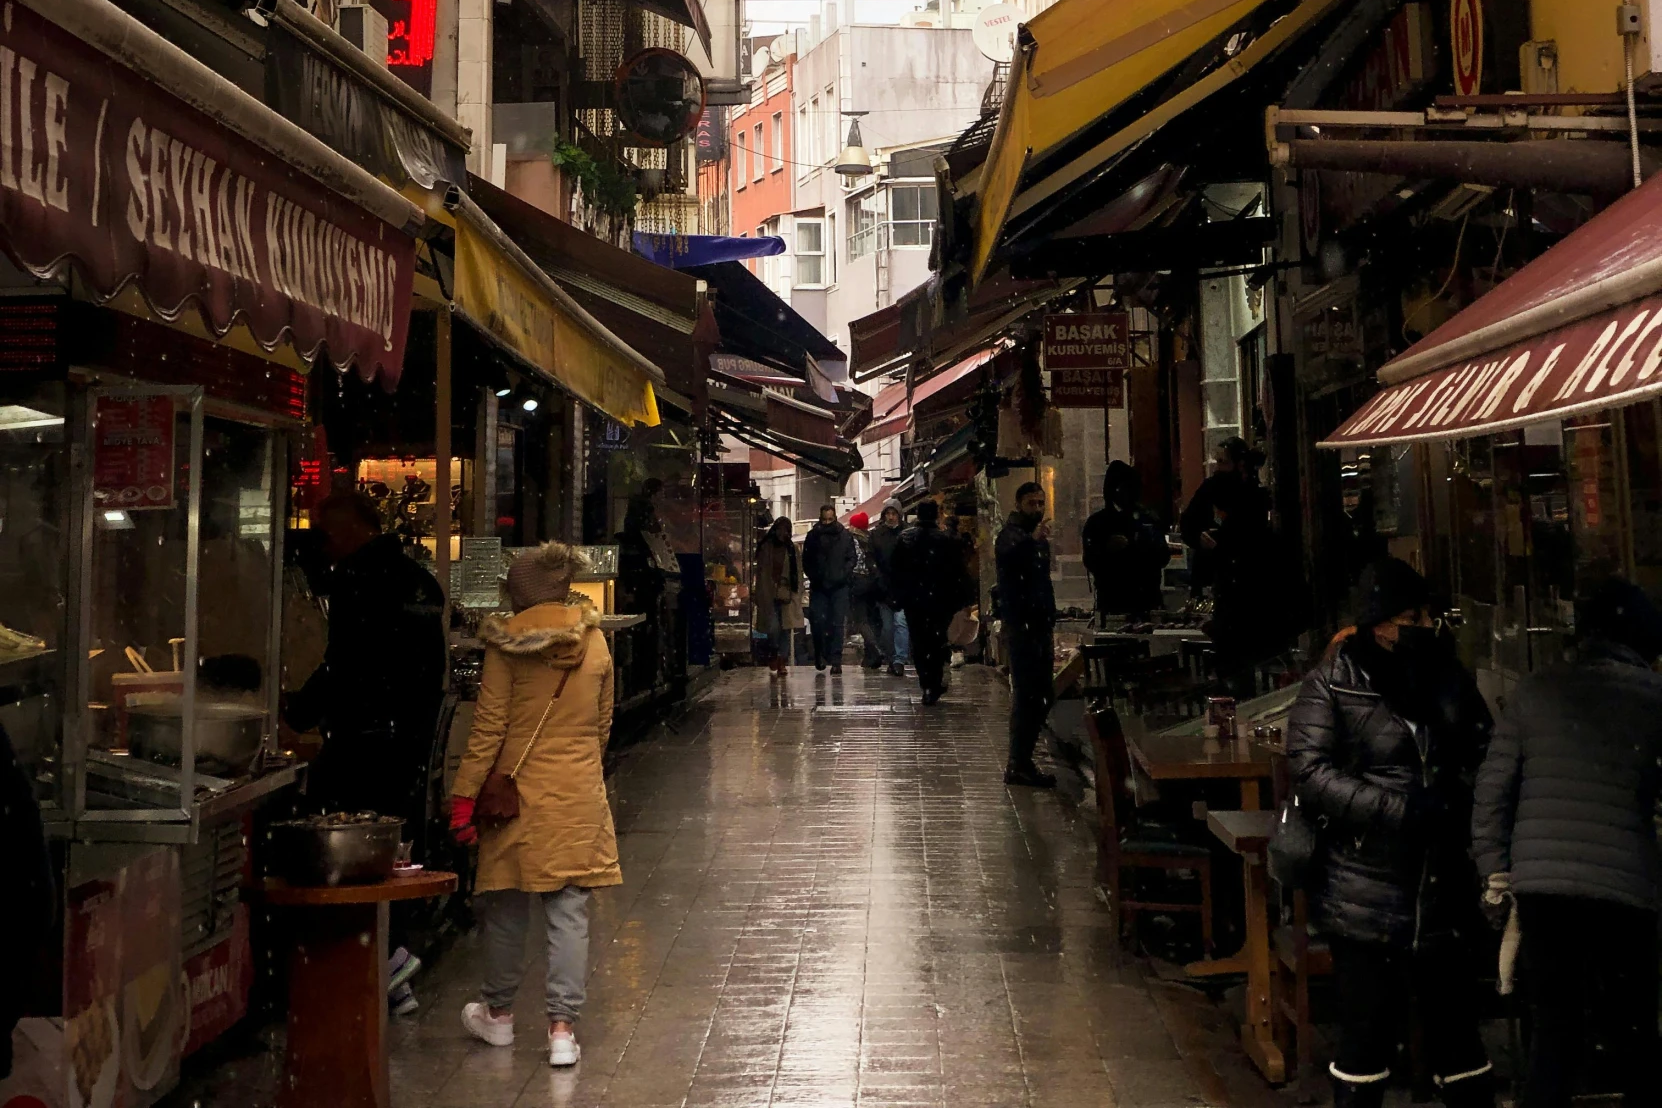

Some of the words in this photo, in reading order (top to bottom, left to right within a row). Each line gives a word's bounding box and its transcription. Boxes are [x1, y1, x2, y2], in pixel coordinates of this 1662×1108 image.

[984, 15, 1012, 27] VESTEL
[126, 117, 260, 283] SEYHAN
[266, 191, 396, 351] KURUYEMİŞ
[1055, 324, 1117, 344] BAŞAK
[1047, 342, 1126, 356] KURUYEMİŞ
[1107, 357, 1122, 365] 6/A
